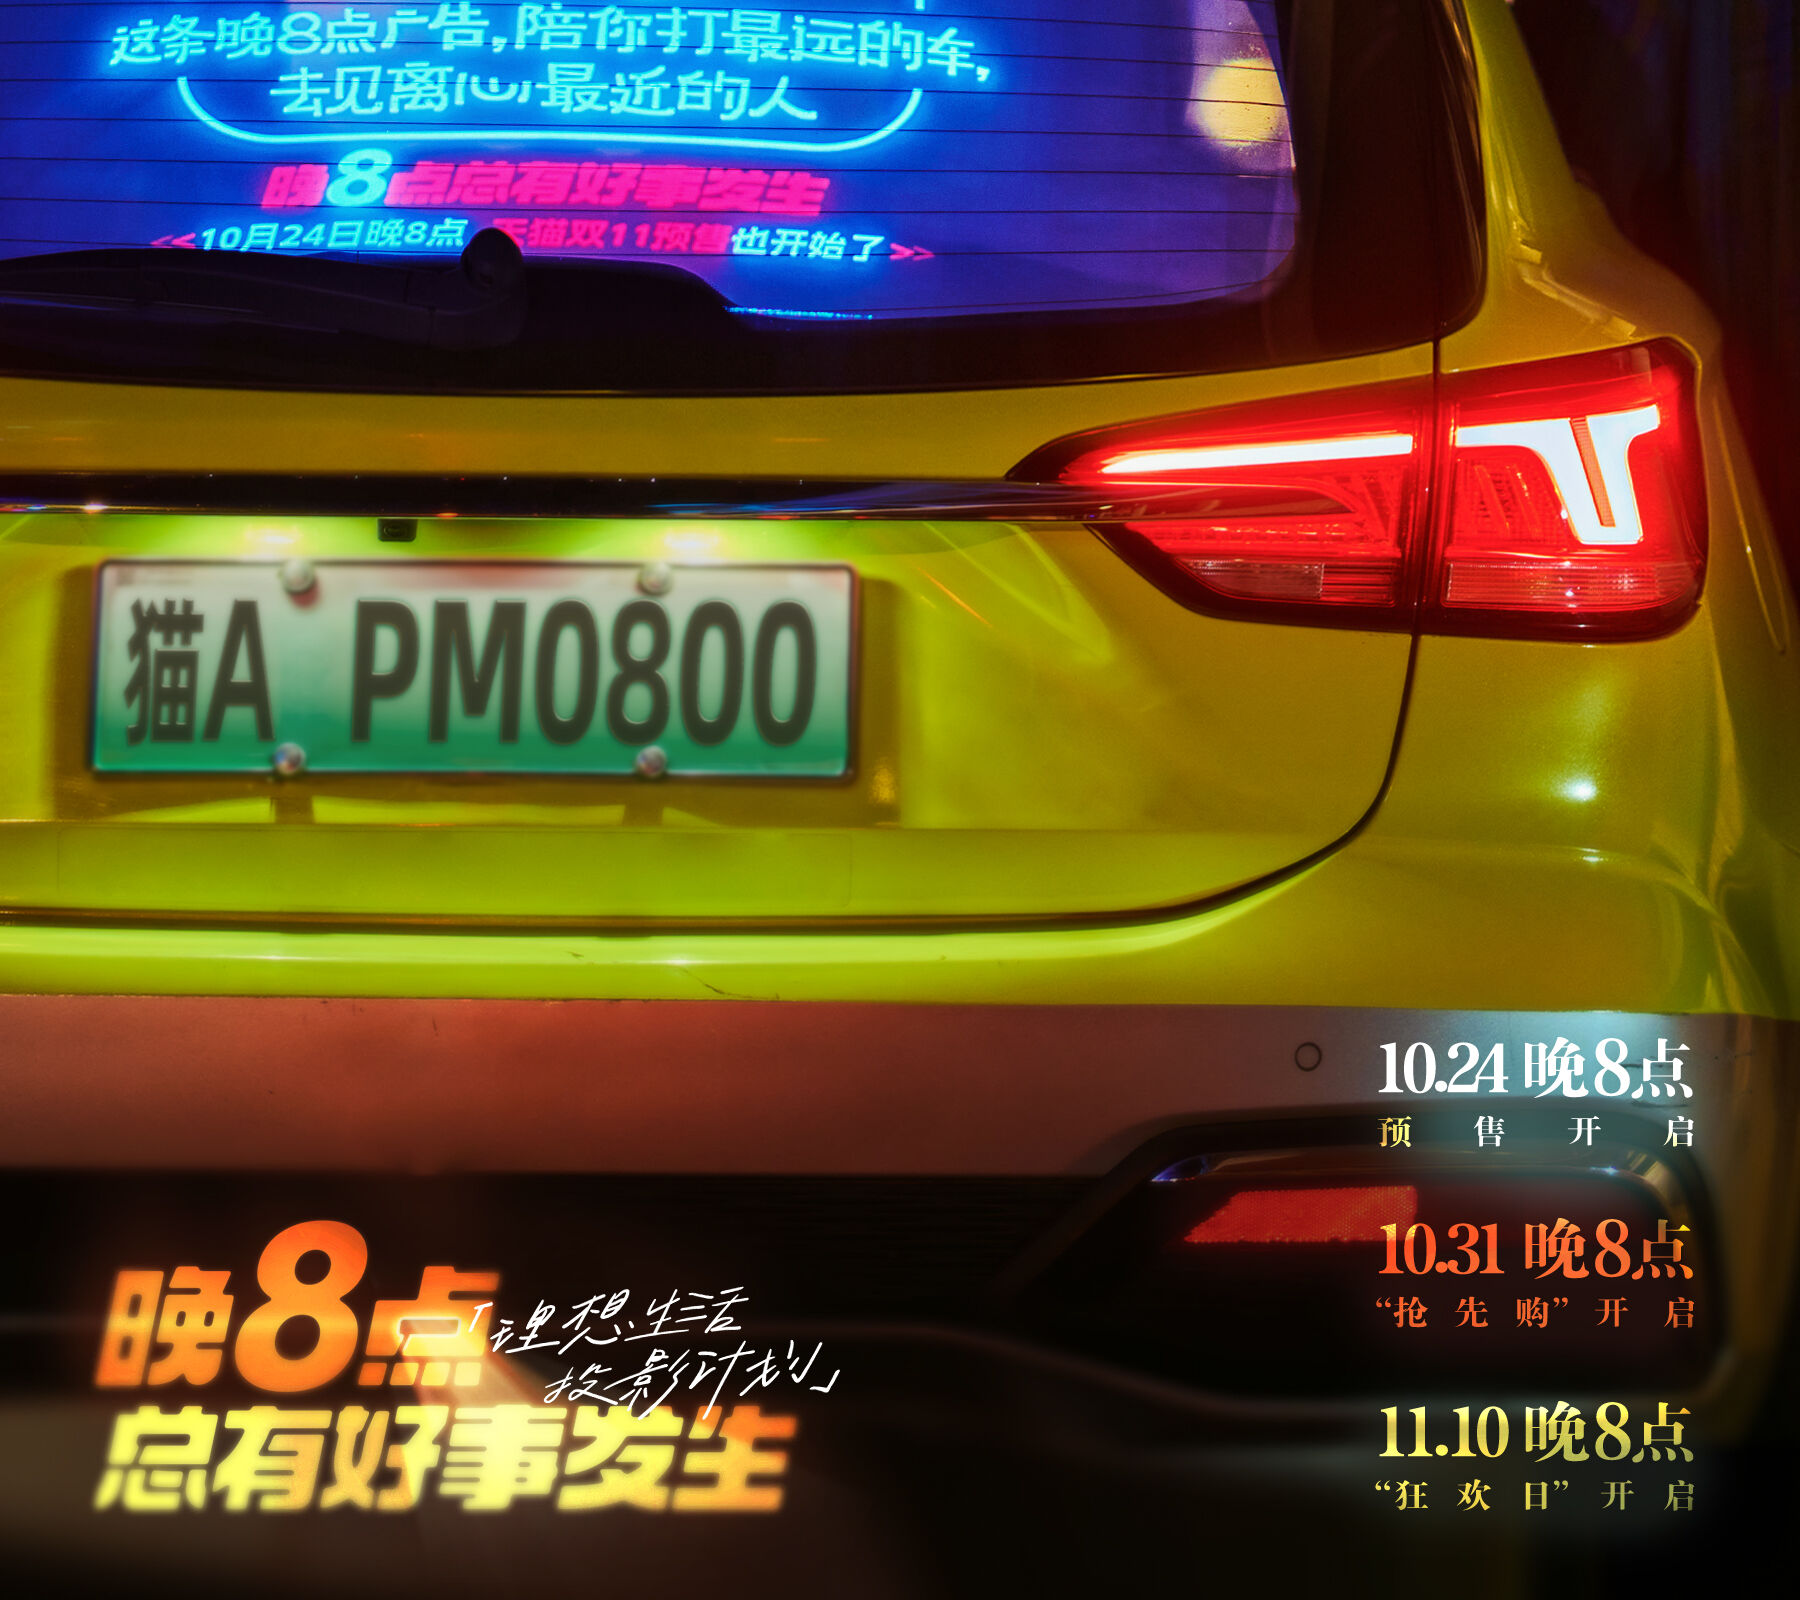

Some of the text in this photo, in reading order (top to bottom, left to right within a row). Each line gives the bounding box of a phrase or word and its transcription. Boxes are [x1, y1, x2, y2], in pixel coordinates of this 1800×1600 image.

[269, 61, 818, 121] 去见离心最近的人
[260, 147, 831, 217] 晚8点总有好事发生
[201, 217, 469, 251] 10月24日晚8点
[124, 598, 818, 746] 猫A PM0800
